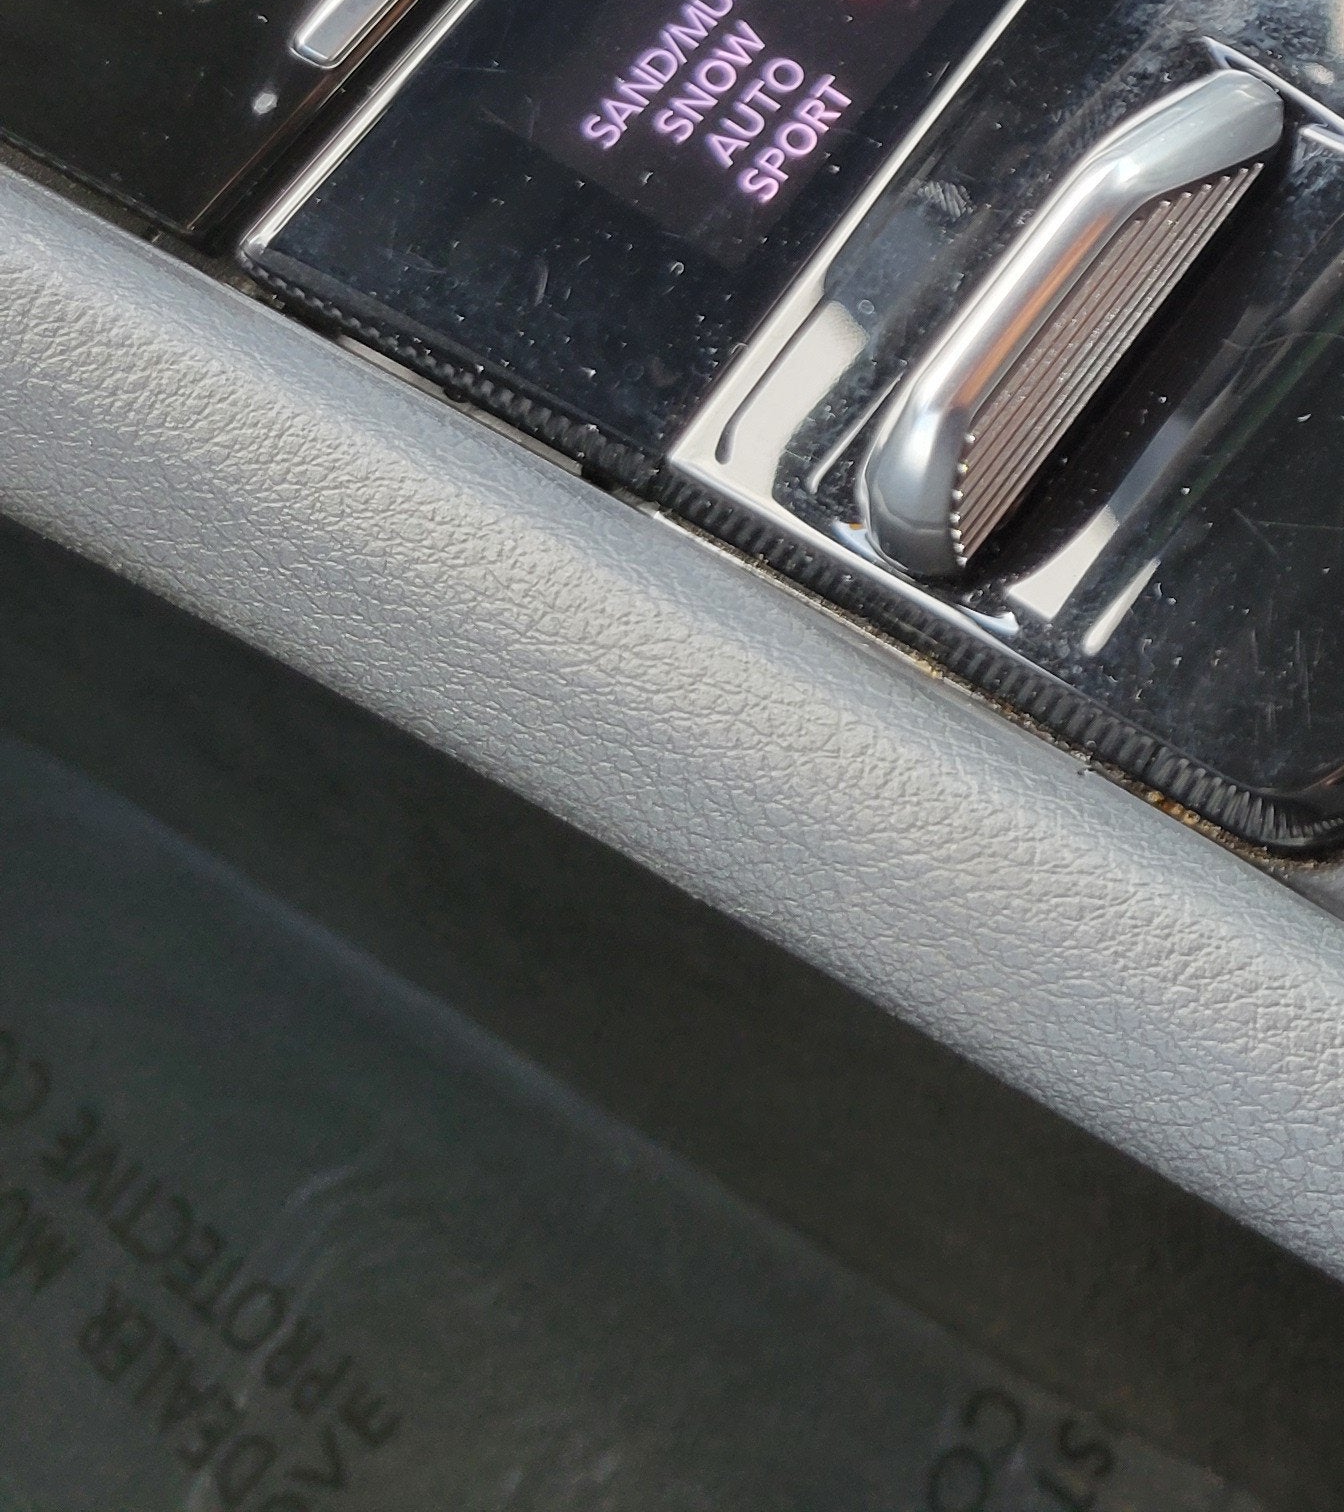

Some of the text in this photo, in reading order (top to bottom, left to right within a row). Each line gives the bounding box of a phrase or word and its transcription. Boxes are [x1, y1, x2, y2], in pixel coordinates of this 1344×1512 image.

[652, 20, 766, 145] SNOW
[705, 57, 805, 169] AUTO
[737, 74, 853, 203] SPORT
[40, 1103, 353, 1420] PROTECTIVE
[78, 1287, 278, 1509] DEALER
